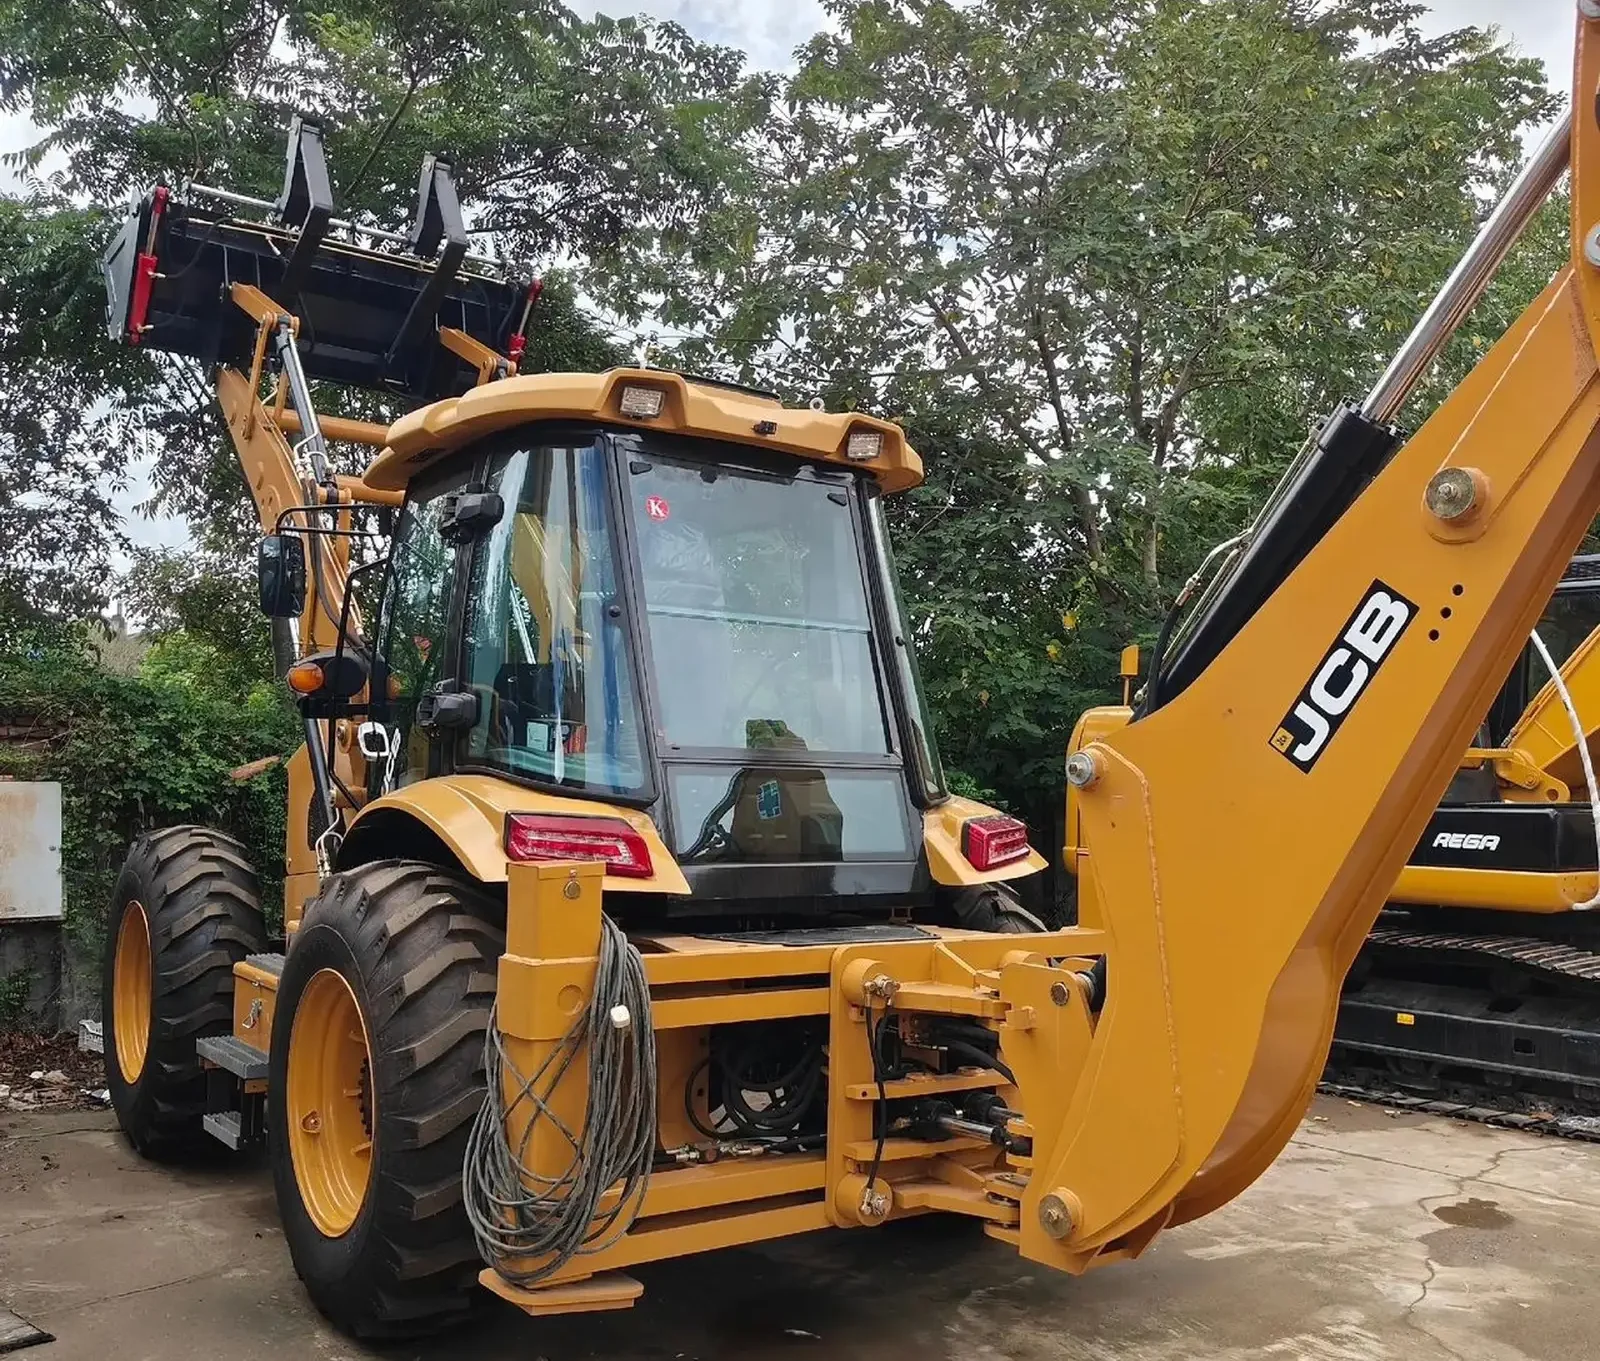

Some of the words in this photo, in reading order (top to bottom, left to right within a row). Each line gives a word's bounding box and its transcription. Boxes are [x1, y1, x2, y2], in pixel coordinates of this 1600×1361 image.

[649, 499, 666, 516] K
[1292, 591, 1409, 762] JCB
[1432, 832, 1501, 851] REGA
